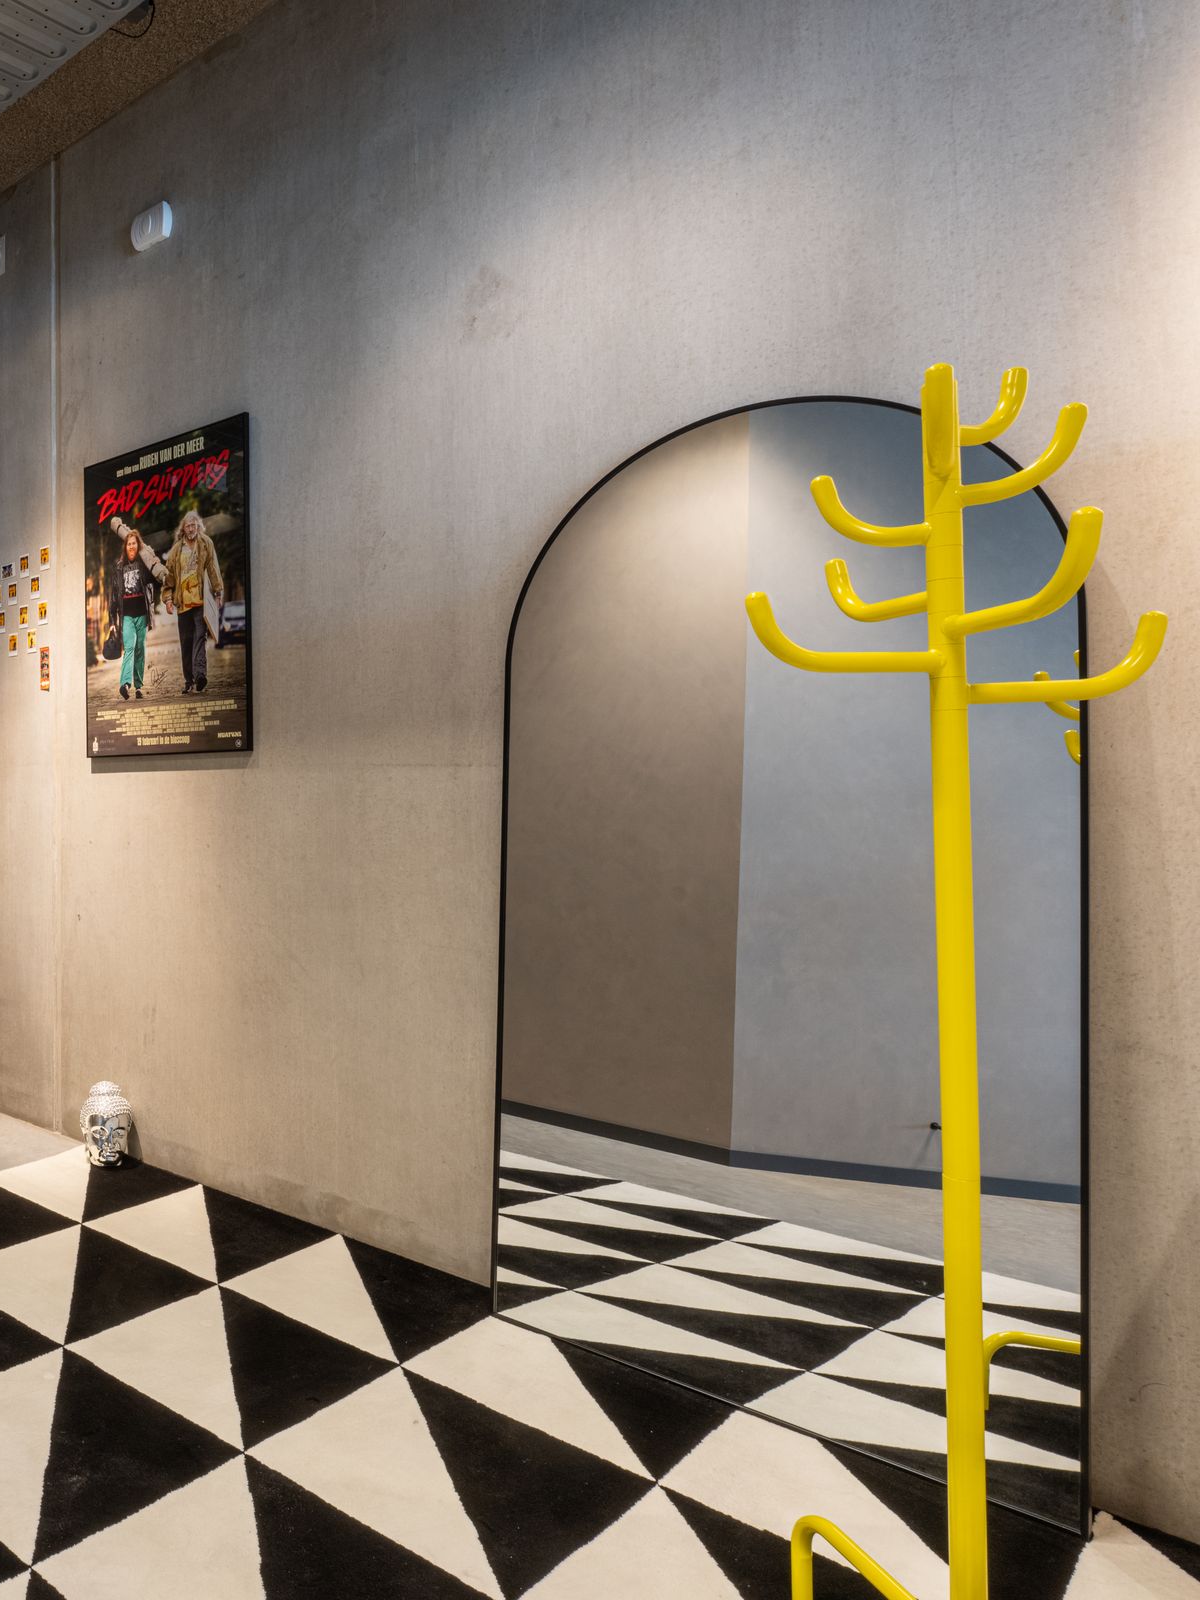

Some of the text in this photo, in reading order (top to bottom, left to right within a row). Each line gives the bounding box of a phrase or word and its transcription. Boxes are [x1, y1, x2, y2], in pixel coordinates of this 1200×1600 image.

[139, 451, 159, 470] RUBEN
[159, 447, 173, 464] VAN
[173, 442, 185, 459] DER
[186, 436, 204, 455] MEER
[97, 480, 143, 524] BAD
